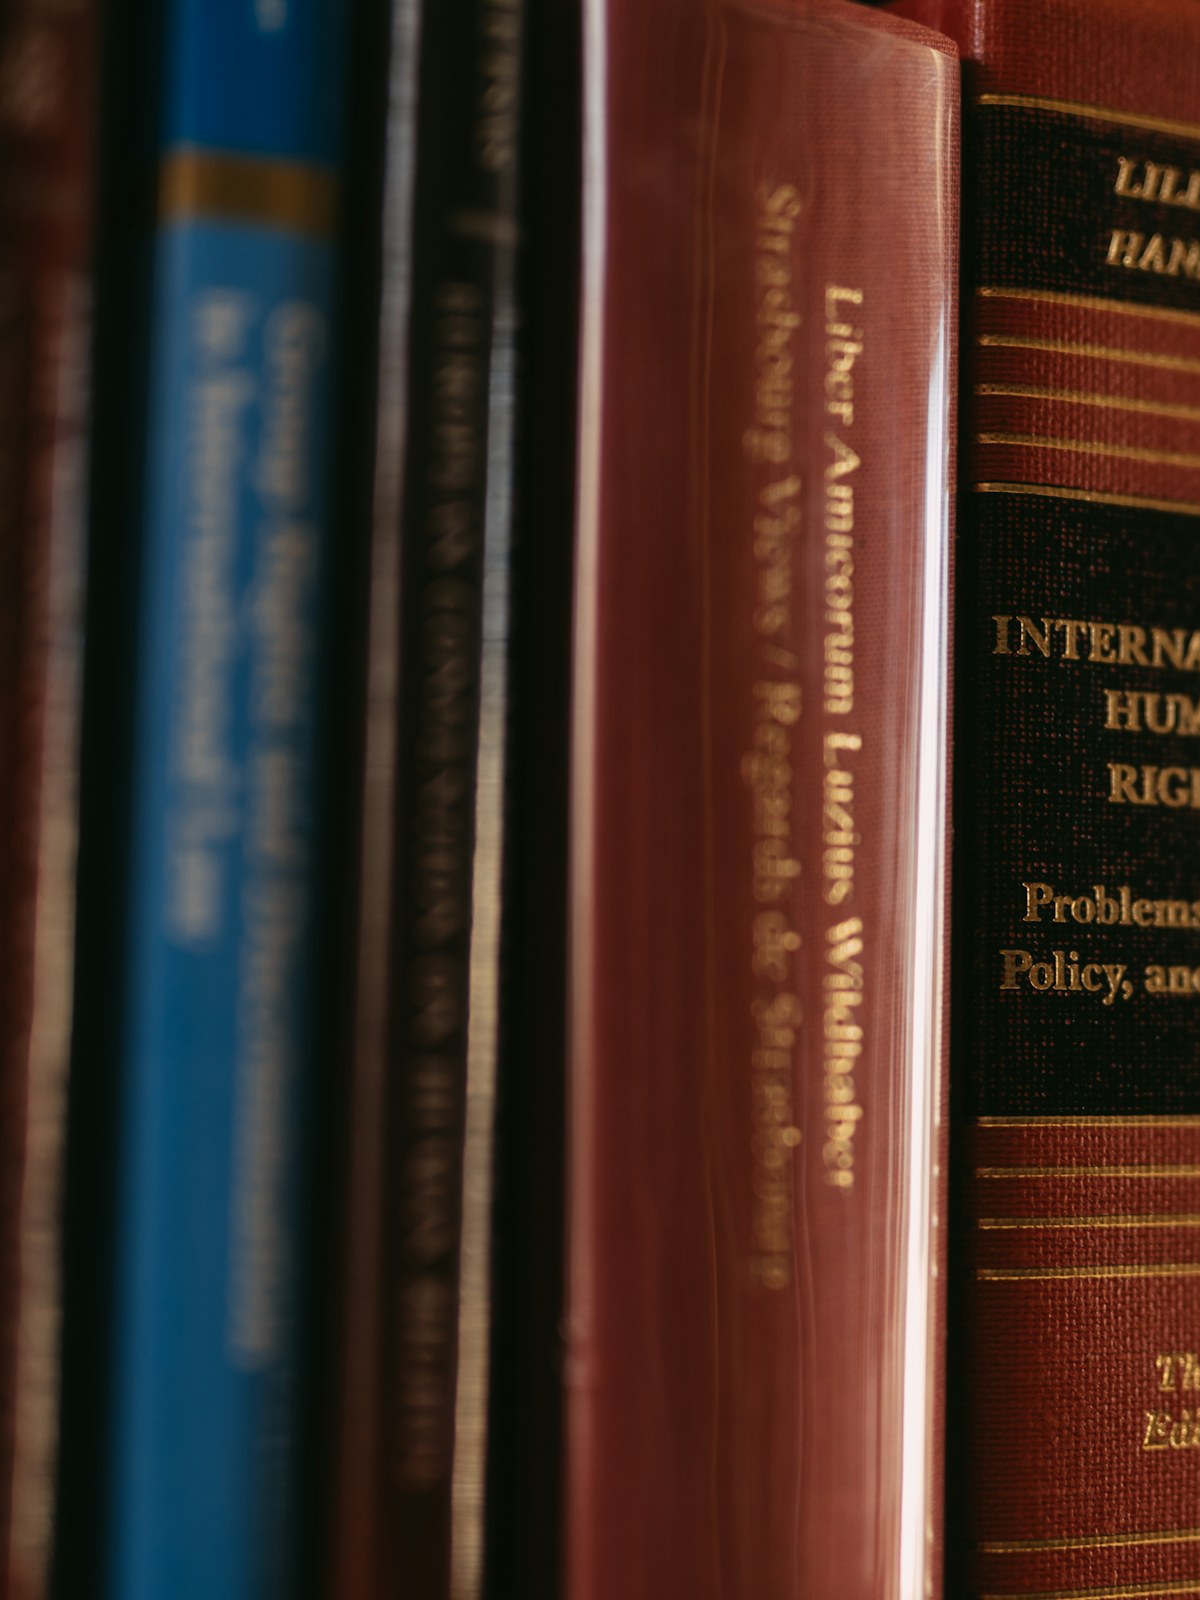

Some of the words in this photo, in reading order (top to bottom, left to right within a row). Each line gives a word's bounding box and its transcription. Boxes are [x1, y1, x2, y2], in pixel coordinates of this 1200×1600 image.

[743, 183, 803, 462] Strasbourg
[824, 284, 863, 426] Liber
[823, 432, 862, 714] Amicorum
[822, 733, 862, 904] Luzius
[822, 916, 864, 1194] Wildhaber
[999, 948, 1134, 1006] Policy,
